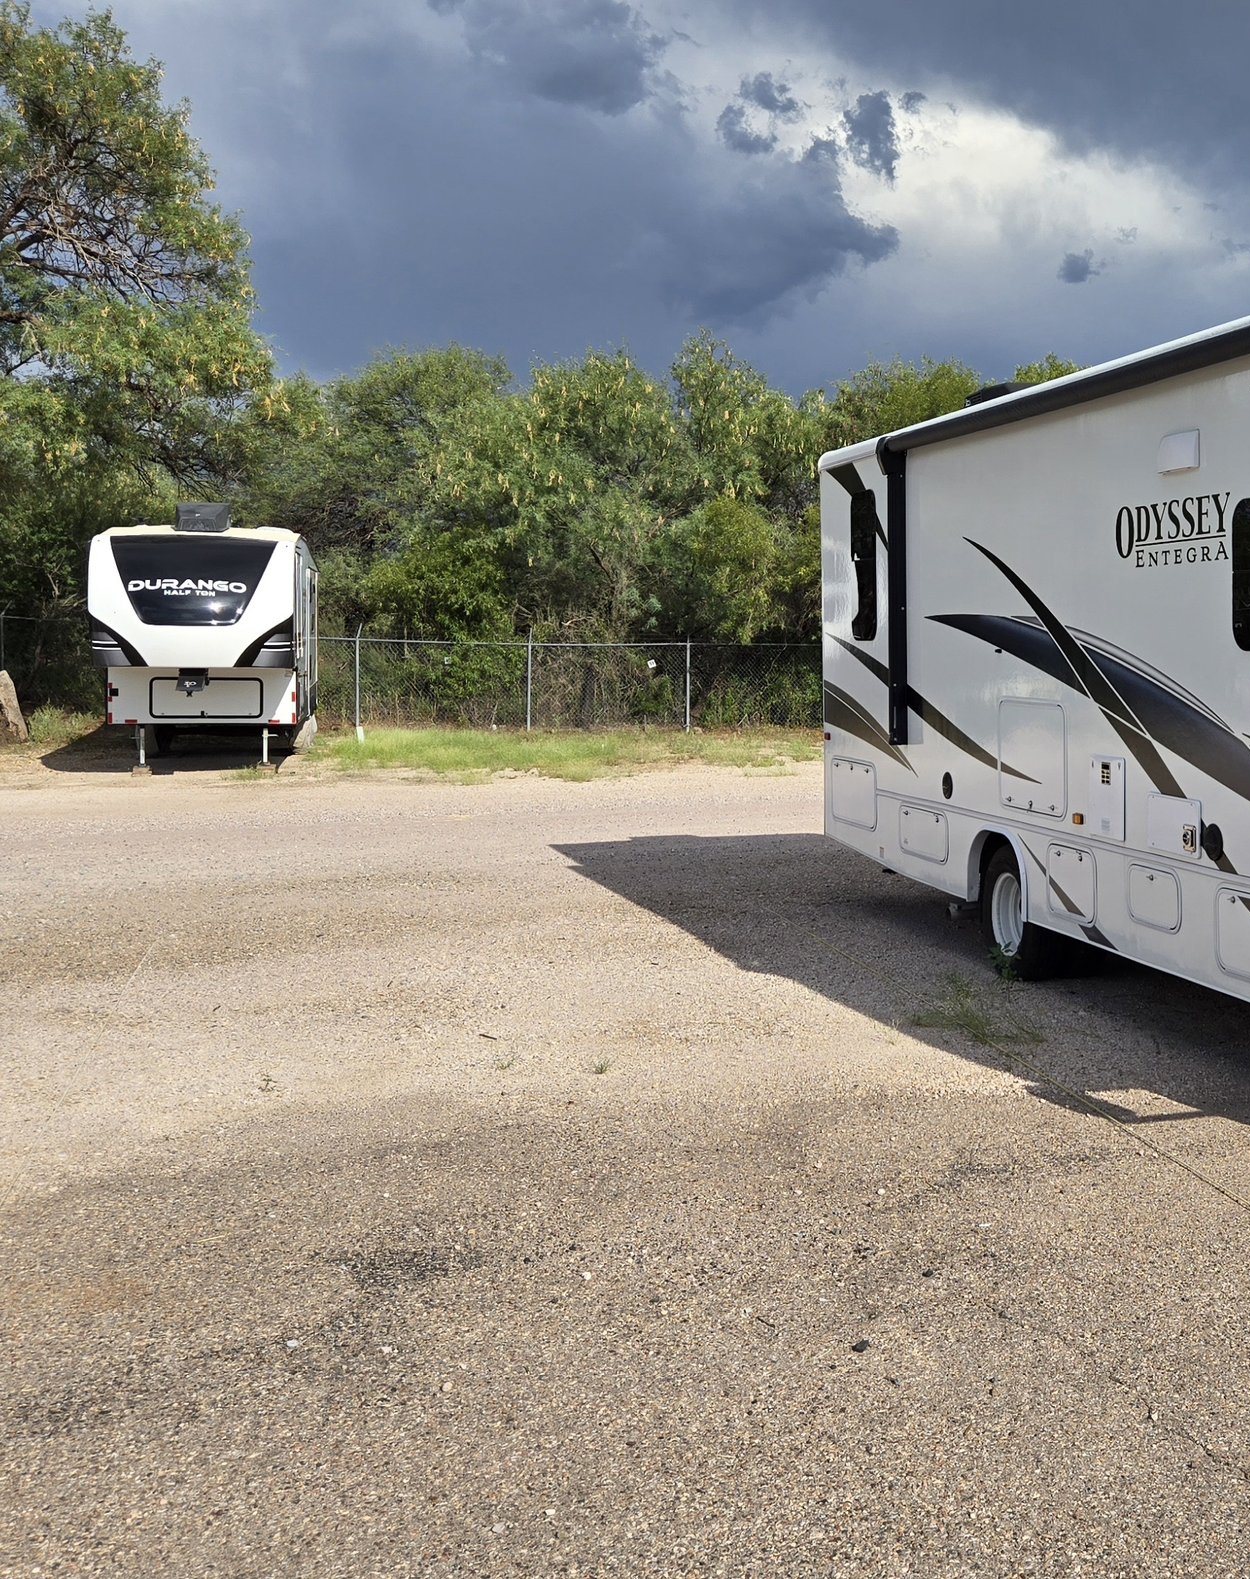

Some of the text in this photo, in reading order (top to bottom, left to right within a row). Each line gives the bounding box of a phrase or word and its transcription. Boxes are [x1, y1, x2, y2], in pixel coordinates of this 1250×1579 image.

[1116, 492, 1230, 558] ODYSSEY
[1135, 541, 1229, 568] ENTEGRA
[128, 579, 247, 593] DURANGO
[195, 589, 216, 597] TON
